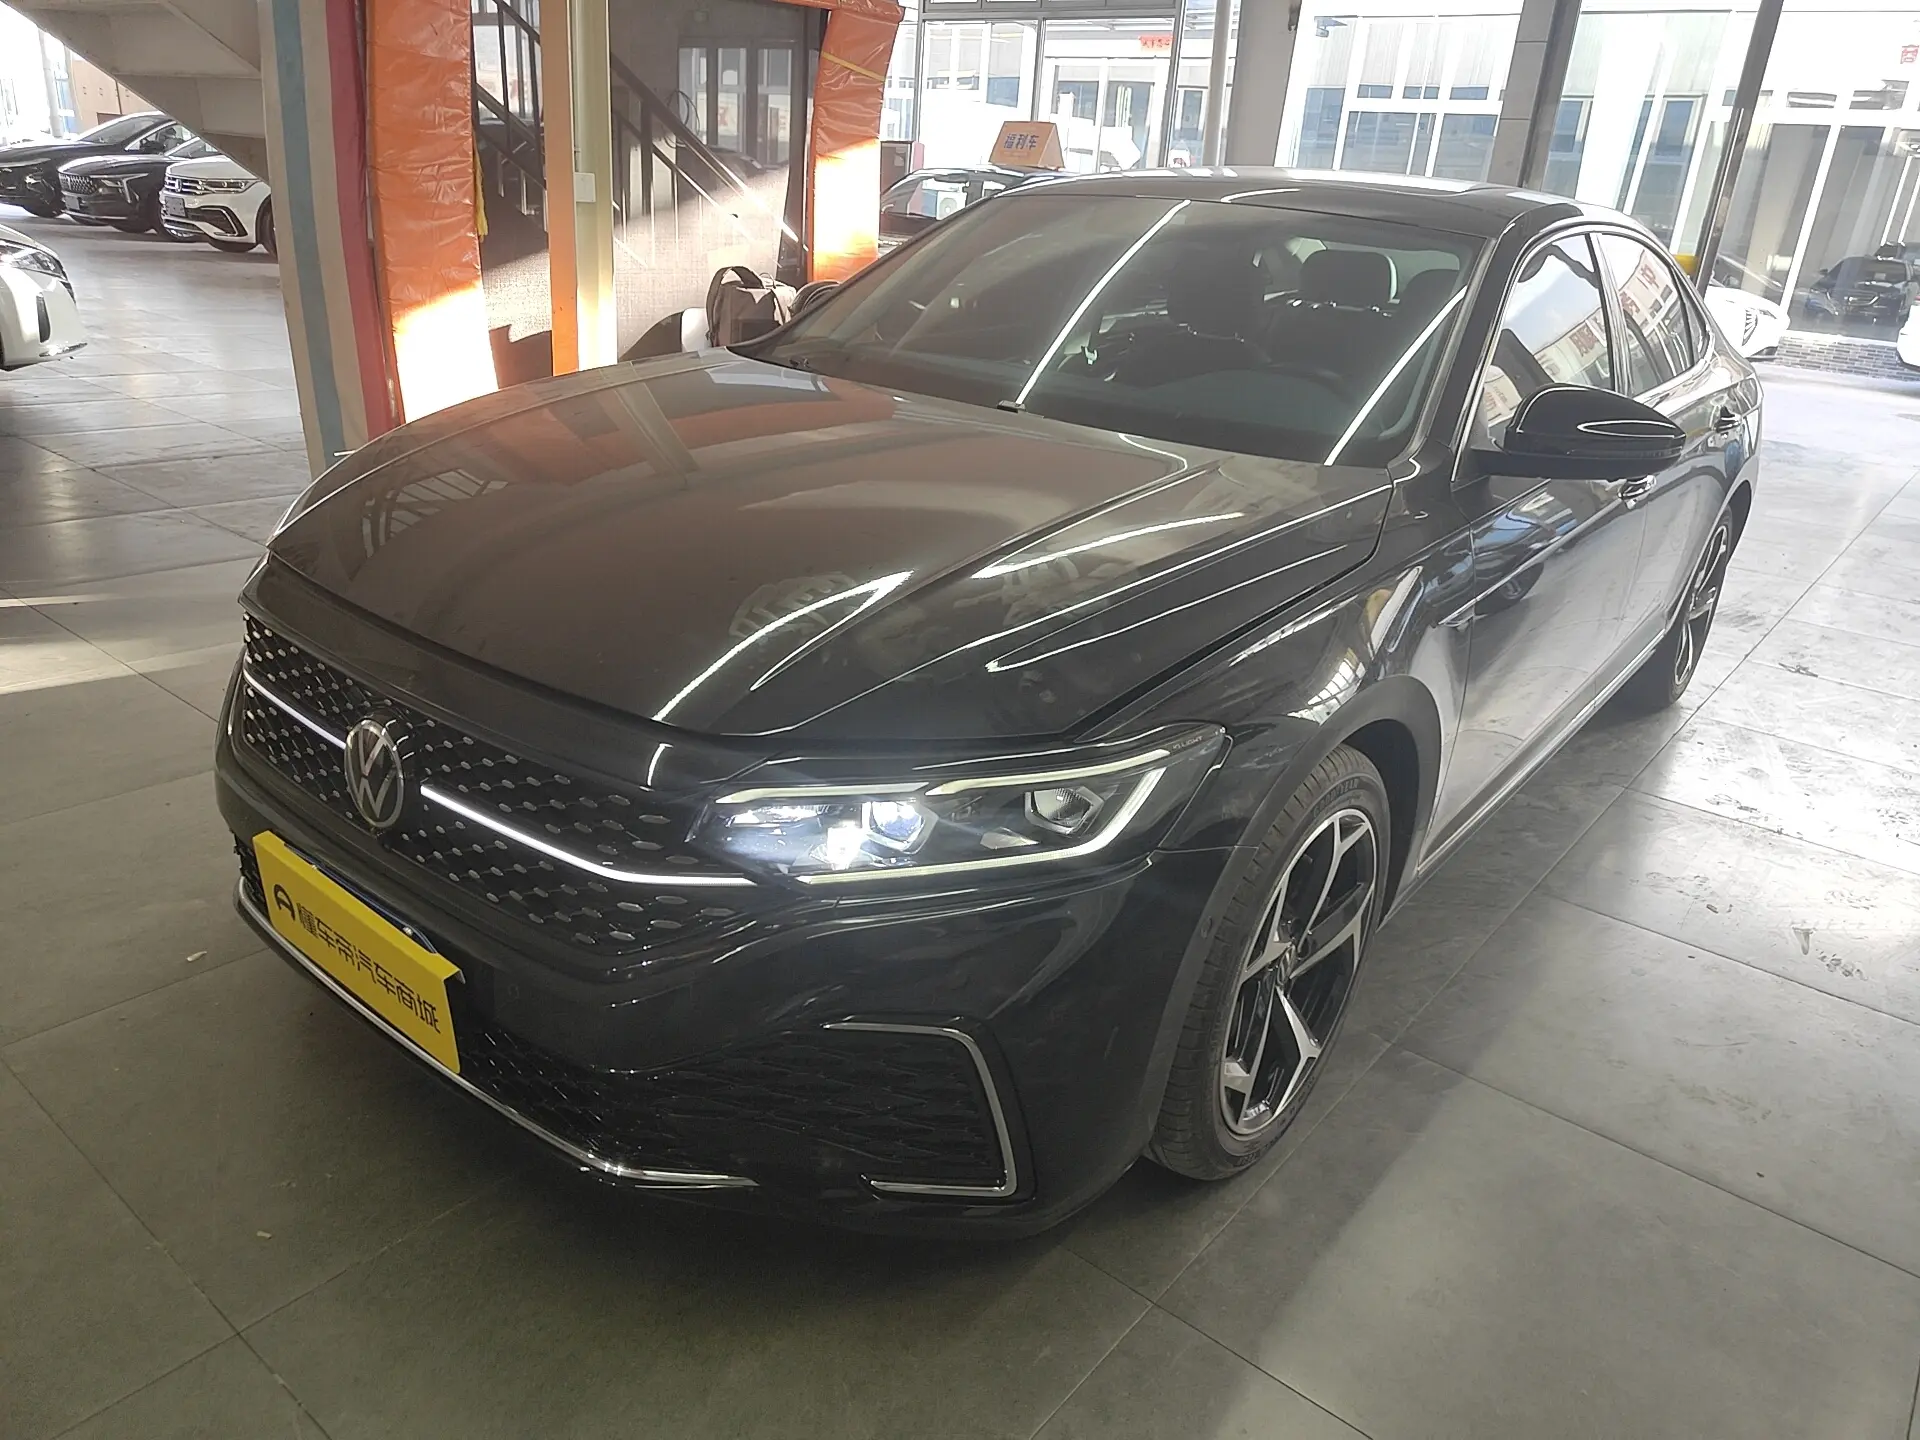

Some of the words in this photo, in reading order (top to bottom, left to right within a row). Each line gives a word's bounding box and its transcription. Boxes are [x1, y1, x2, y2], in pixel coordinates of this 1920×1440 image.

[296, 902, 441, 1034] 懂车帝汽车商城
